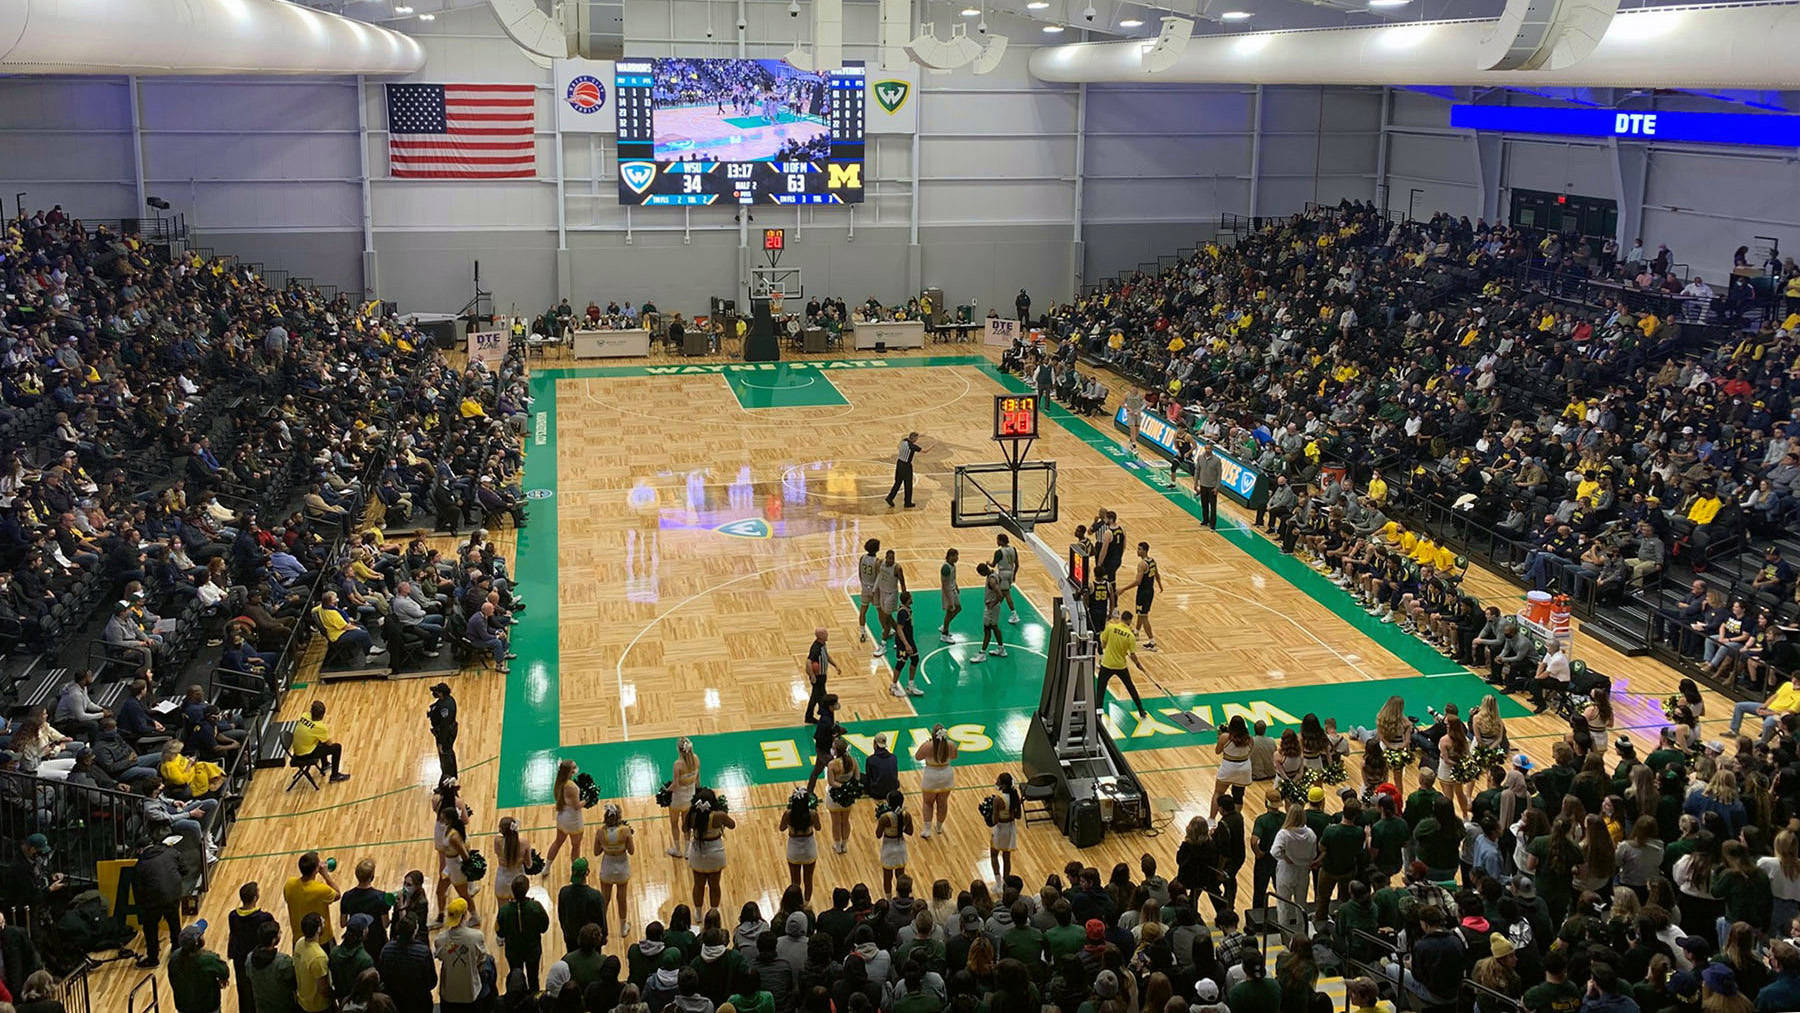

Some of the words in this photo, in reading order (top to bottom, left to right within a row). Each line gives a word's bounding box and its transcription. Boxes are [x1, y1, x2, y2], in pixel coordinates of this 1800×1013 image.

[645, 118, 650, 127] 2
[1615, 113, 1657, 135] DTE
[645, 128, 650, 137] 7
[683, 162, 702, 173] WSU
[727, 163, 753, 178] 13:17
[828, 163, 861, 188] M
[683, 175, 702, 193] 34
[752, 181, 757, 190] 2
[787, 174, 805, 192] 63
[766, 237, 782, 248] 20
[992, 320, 1013, 330] DTE
[477, 334, 500, 343] DTE
[647, 363, 777, 375] WAYNE
[788, 359, 889, 370] STATE
[1002, 398, 1033, 410] 13:17
[1002, 411, 1031, 434] 20
[862, 563, 873, 576] 33
[1095, 590, 1107, 601] 55
[1114, 627, 1131, 638] STAFF
